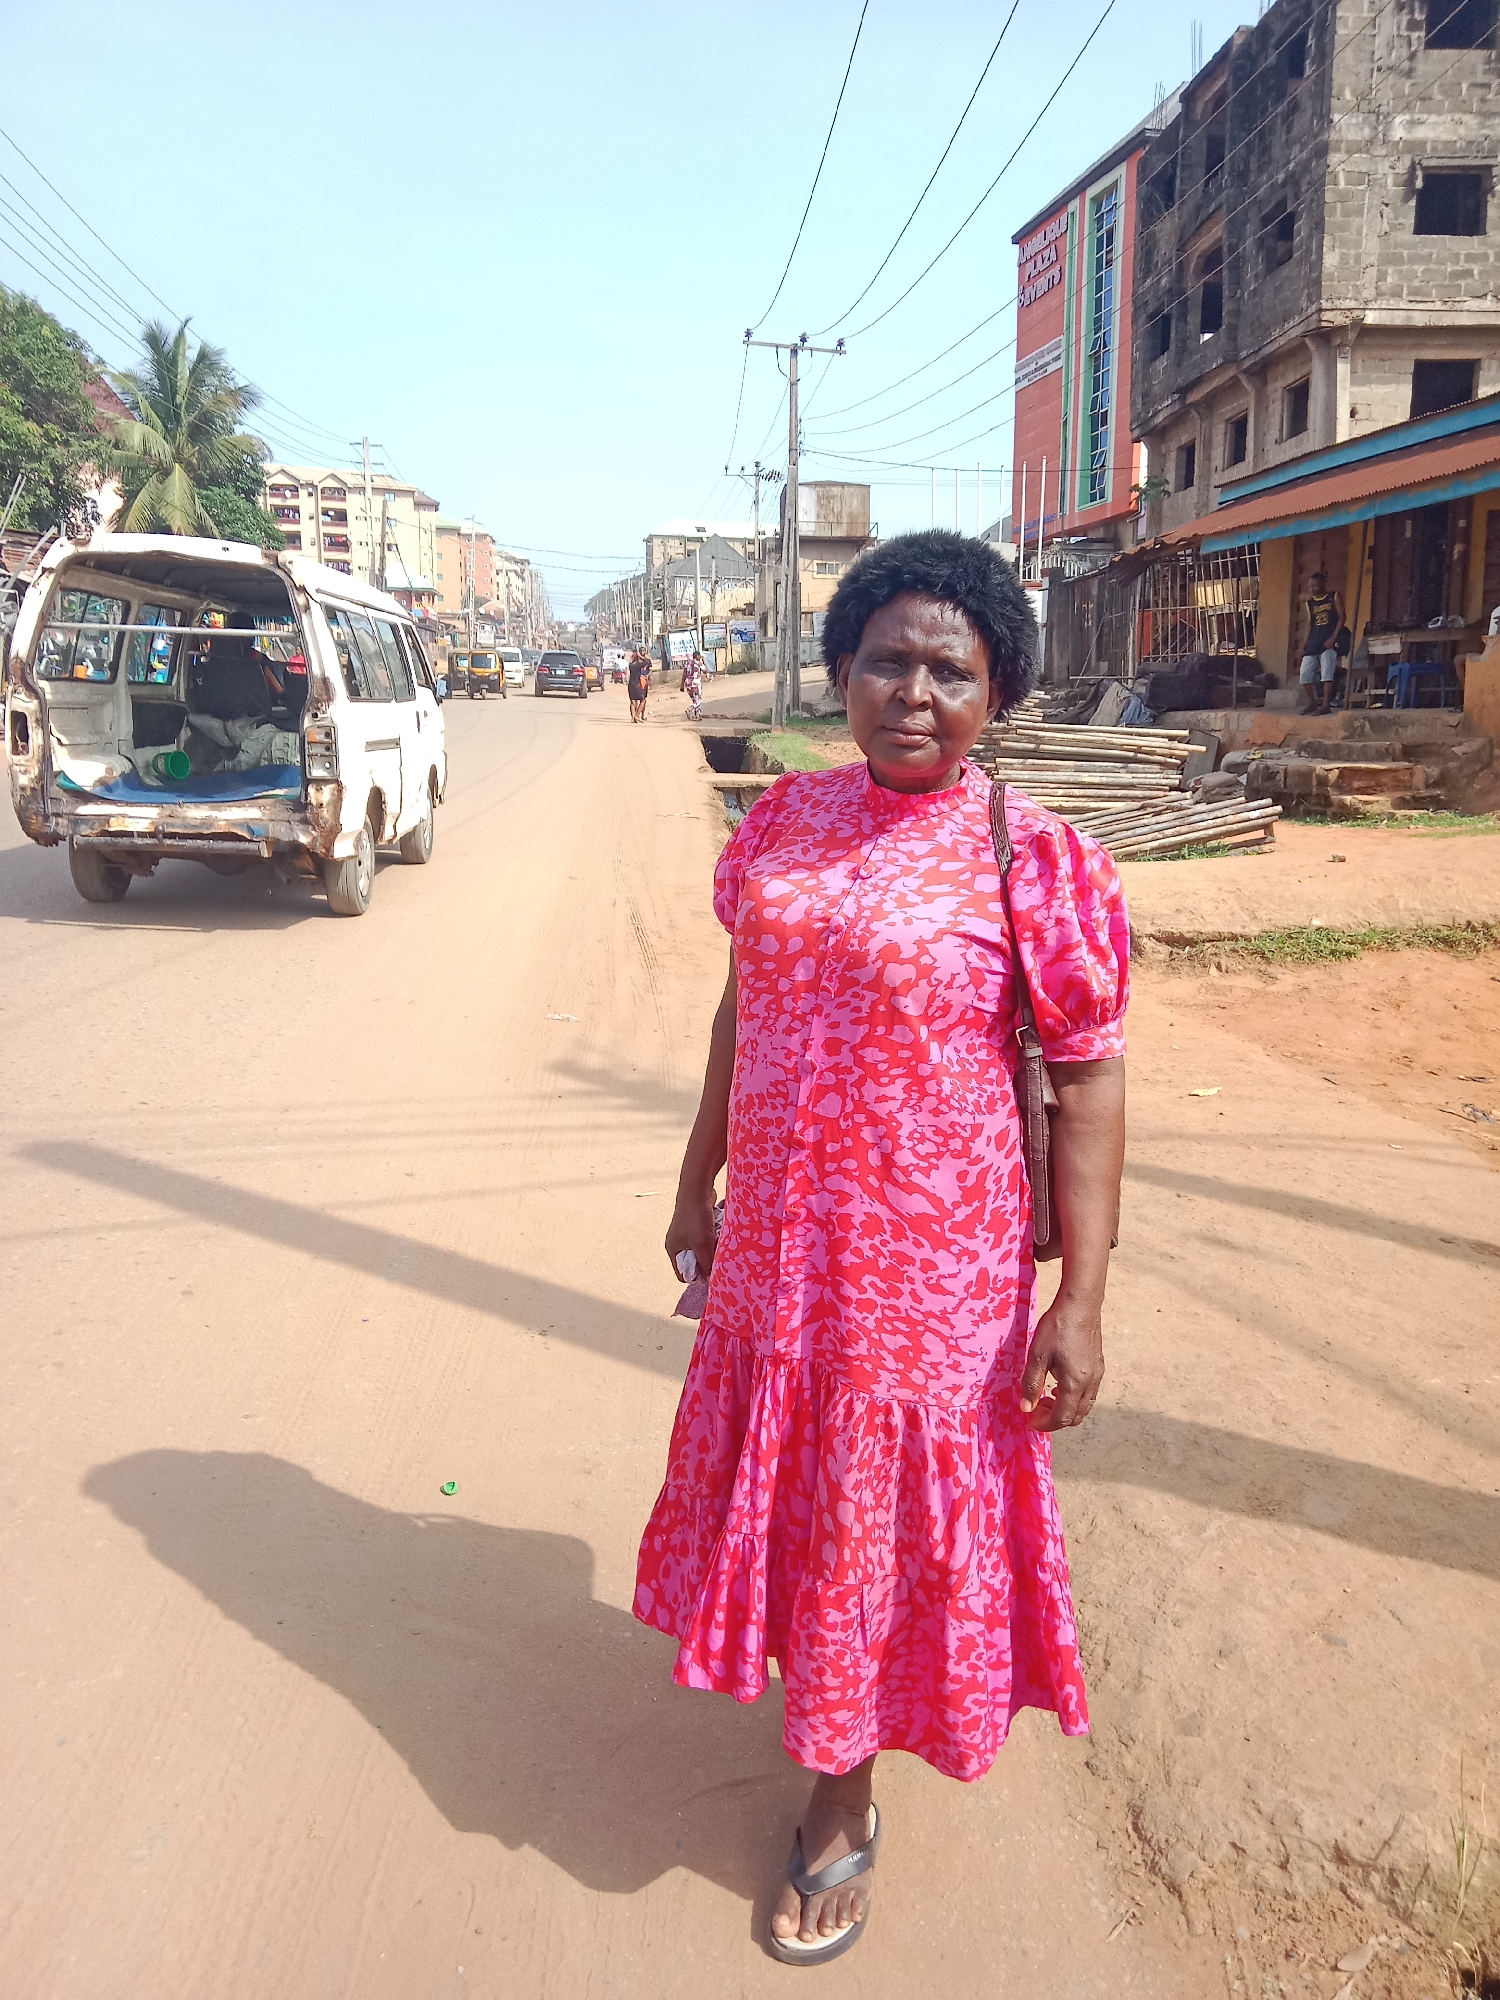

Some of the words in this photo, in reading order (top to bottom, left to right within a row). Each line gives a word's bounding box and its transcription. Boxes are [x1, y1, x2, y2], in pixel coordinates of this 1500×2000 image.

[1017, 212, 1069, 266] ANGELIQUE
[1025, 244, 1058, 282] PLAZA
[1018, 286, 1025, 307] &
[1024, 265, 1062, 307] EVENTS
